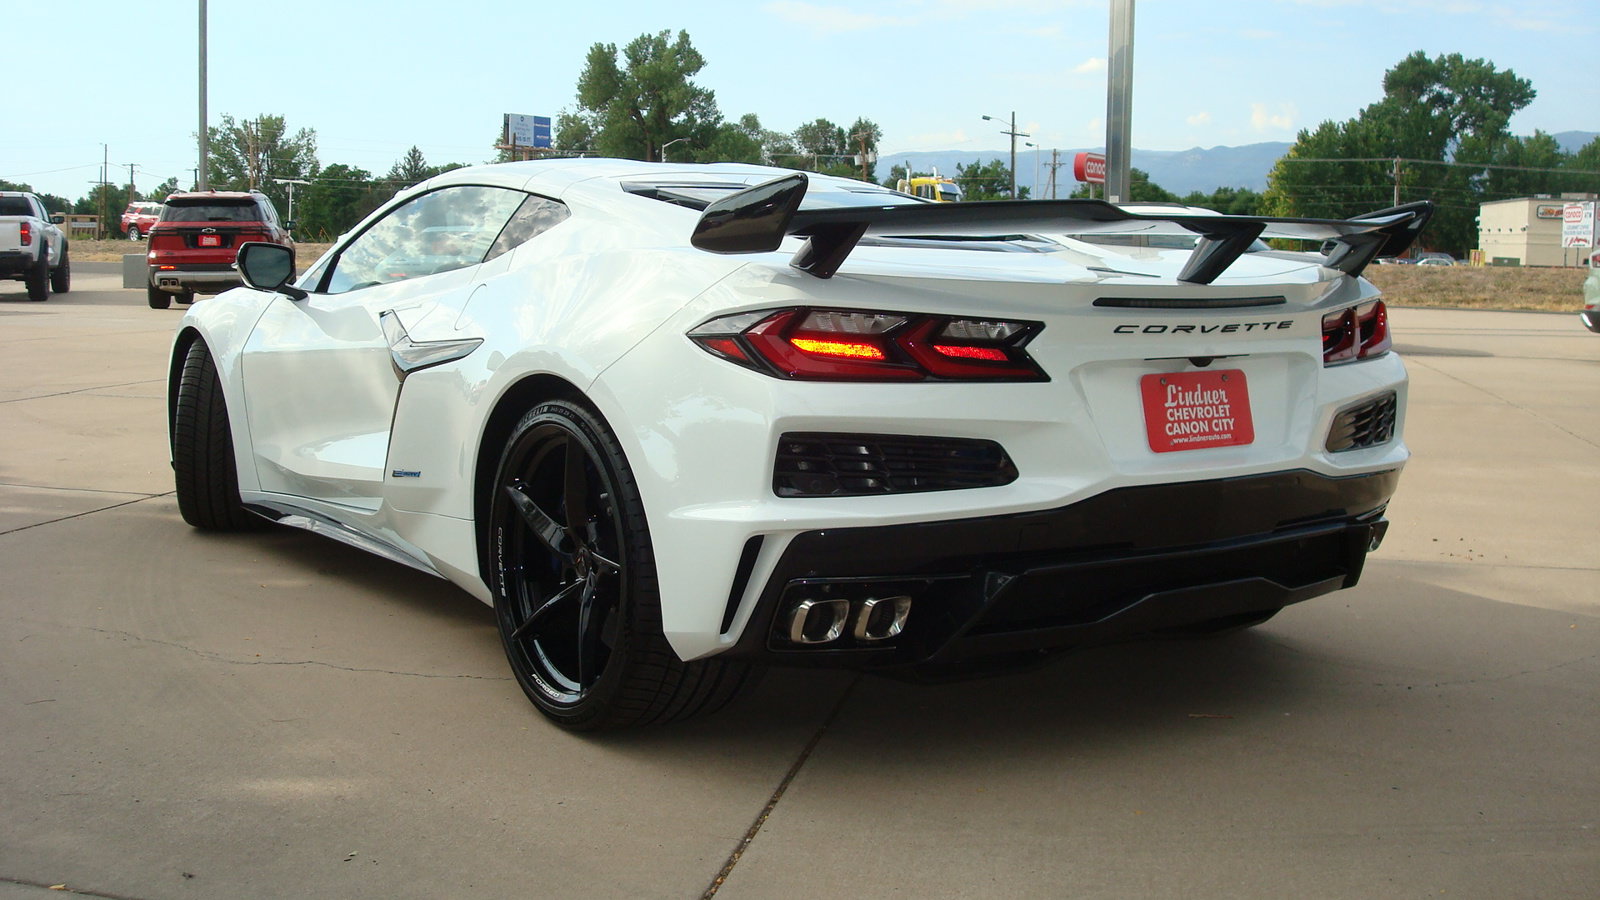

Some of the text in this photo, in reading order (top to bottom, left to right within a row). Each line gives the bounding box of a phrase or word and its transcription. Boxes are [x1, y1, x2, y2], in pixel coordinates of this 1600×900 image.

[1113, 320, 1294, 334] CORVETTE
[1164, 383, 1228, 407] Lindner
[1167, 404, 1230, 421] CHEVROLET
[1165, 417, 1235, 436] CANON CITY
[531, 673, 560, 698] FORGED
